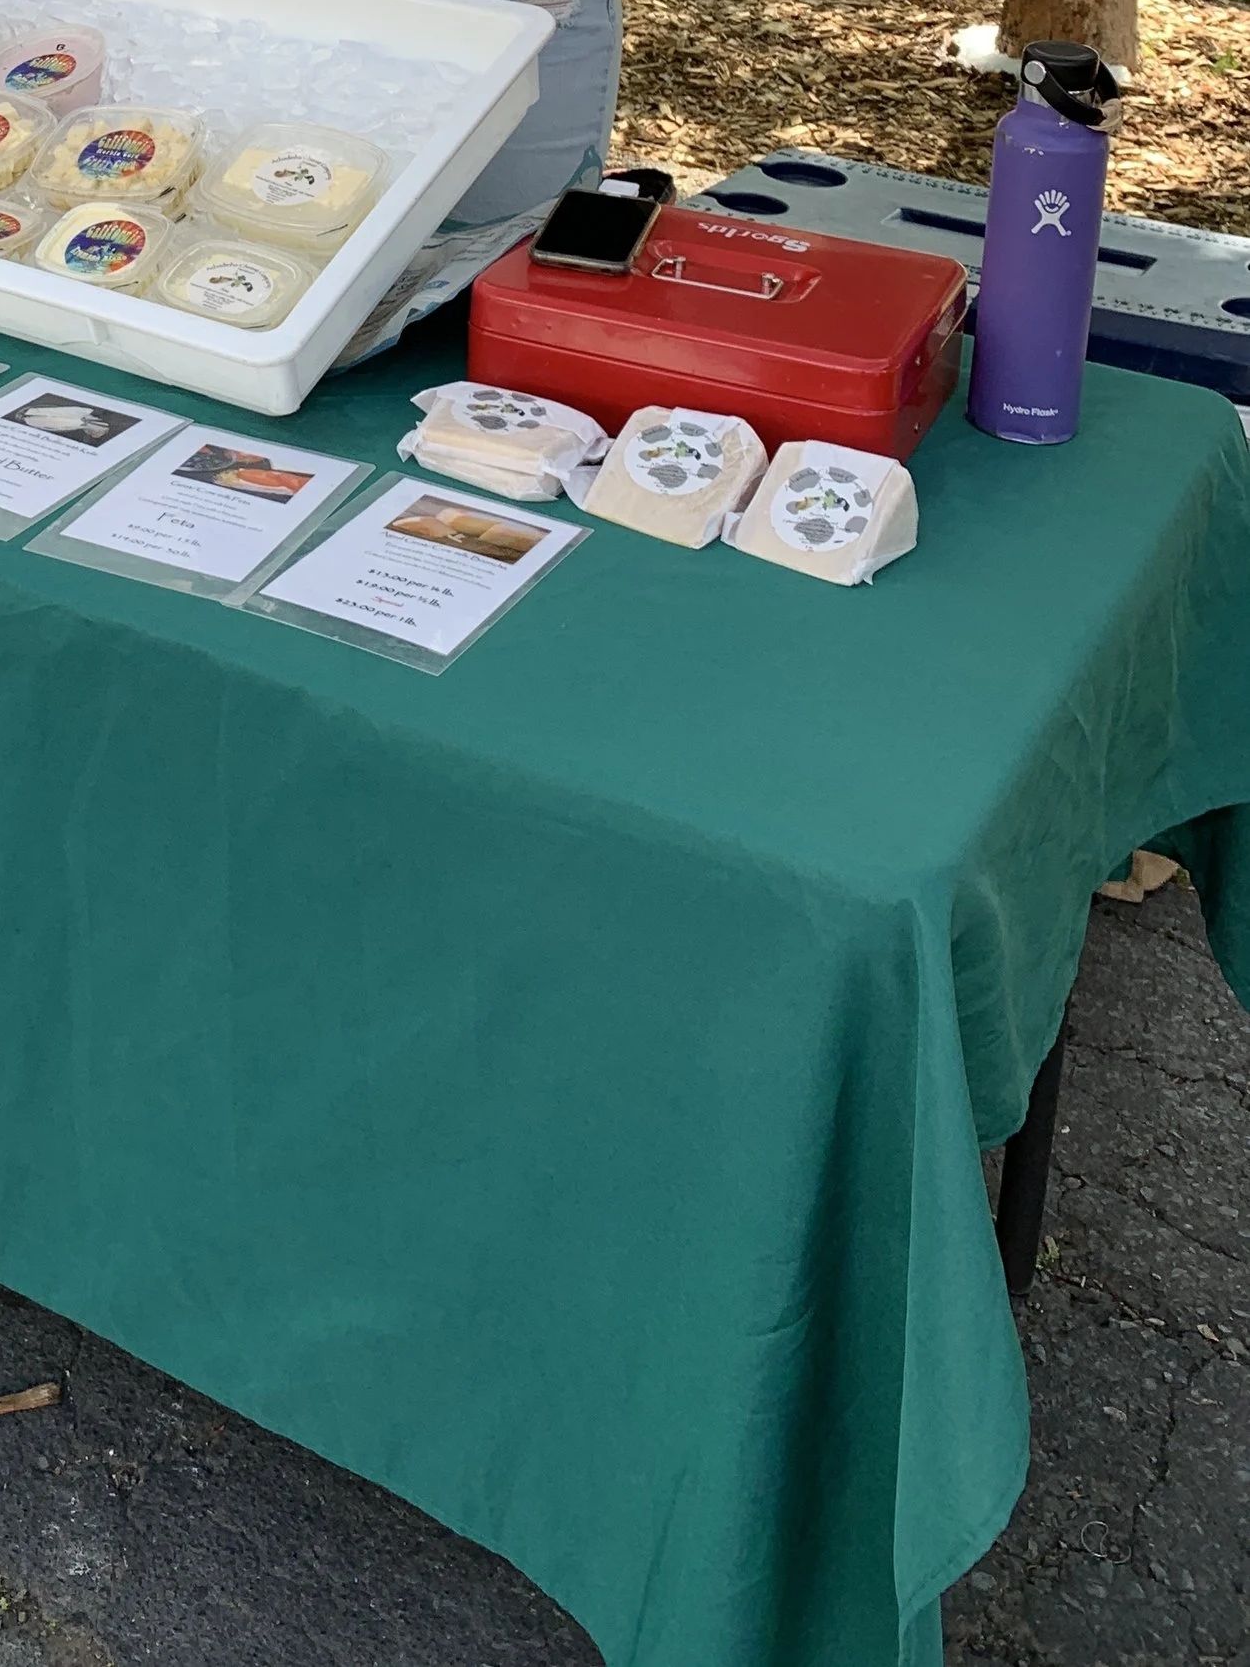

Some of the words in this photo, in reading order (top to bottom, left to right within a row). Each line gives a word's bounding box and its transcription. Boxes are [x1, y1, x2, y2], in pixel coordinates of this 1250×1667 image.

[1002, 402, 1031, 415] Hydro
[3, 459, 56, 481] Butter
[156, 511, 196, 530] Feta
